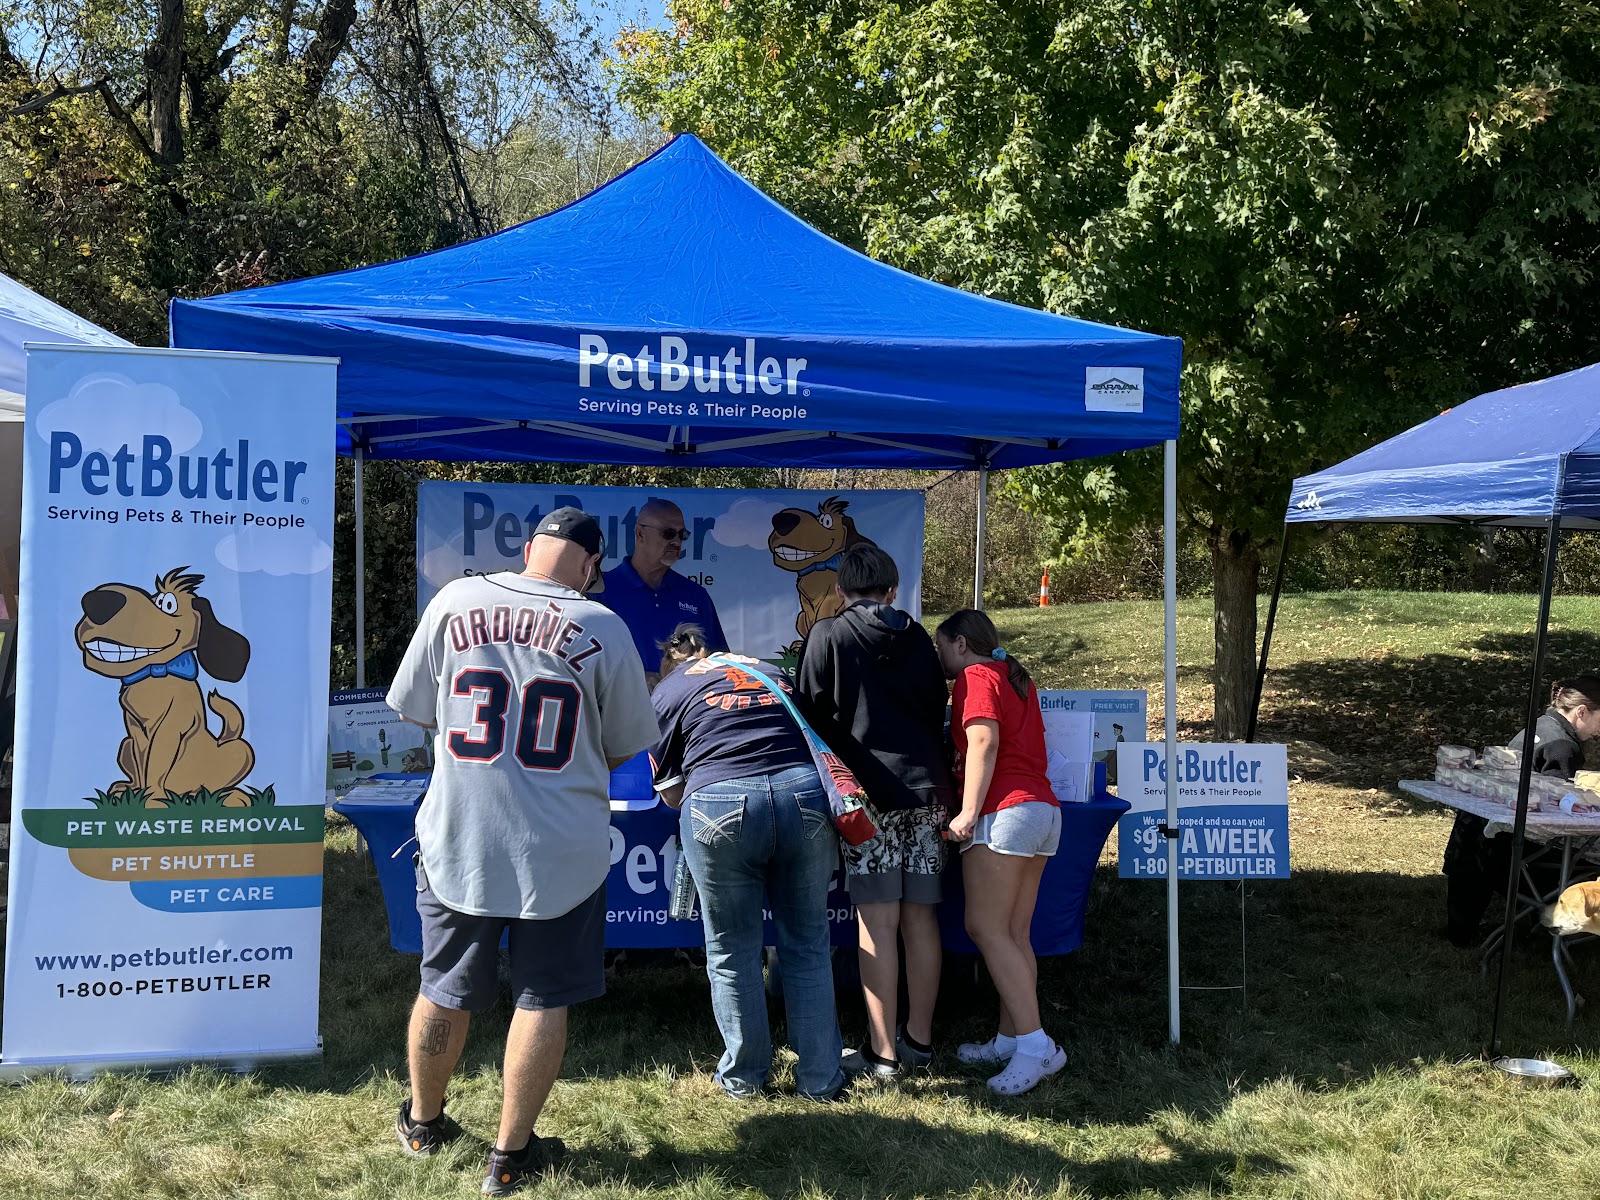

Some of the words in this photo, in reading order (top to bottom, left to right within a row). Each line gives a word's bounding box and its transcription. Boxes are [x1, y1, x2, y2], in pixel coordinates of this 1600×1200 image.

[579, 334, 808, 395] PetButler
[578, 398, 642, 416] Serving
[647, 401, 683, 415] Pets
[688, 403, 699, 416] &
[704, 403, 746, 417] Their
[751, 405, 807, 421] People
[48, 431, 308, 503] PetButler
[47, 505, 119, 524] Serving
[126, 508, 165, 523] Pets
[171, 510, 183, 523] &
[190, 510, 236, 525] Their
[243, 513, 305, 529] People
[333, 692, 385, 701] COMMERCIAL
[446, 665, 583, 773] 30
[1179, 788, 1198, 796] Pets
[1200, 788, 1206, 796] &
[1209, 788, 1231, 796] Their
[1232, 788, 1262, 797] People
[67, 821, 107, 836] PET
[115, 819, 193, 835] WASTE
[201, 817, 305, 834] REMOVAL
[1143, 816, 1155, 825] We
[1177, 816, 1203, 827] cooped
[1205, 816, 1220, 825] and
[1249, 816, 1266, 827] you!
[1181, 828, 1199, 854] A
[1203, 828, 1275, 854] WEEK
[112, 856, 152, 871] PET
[159, 854, 255, 870] SHUTTLE
[1133, 857, 1276, 875] 1-80-PETBUTLER
[170, 889, 209, 903] PET
[217, 887, 274, 902] CARE
[605, 907, 668, 925] erving
[35, 945, 293, 971] www.petbutler.com
[56, 974, 271, 998] 1-800-PETBUTLER
